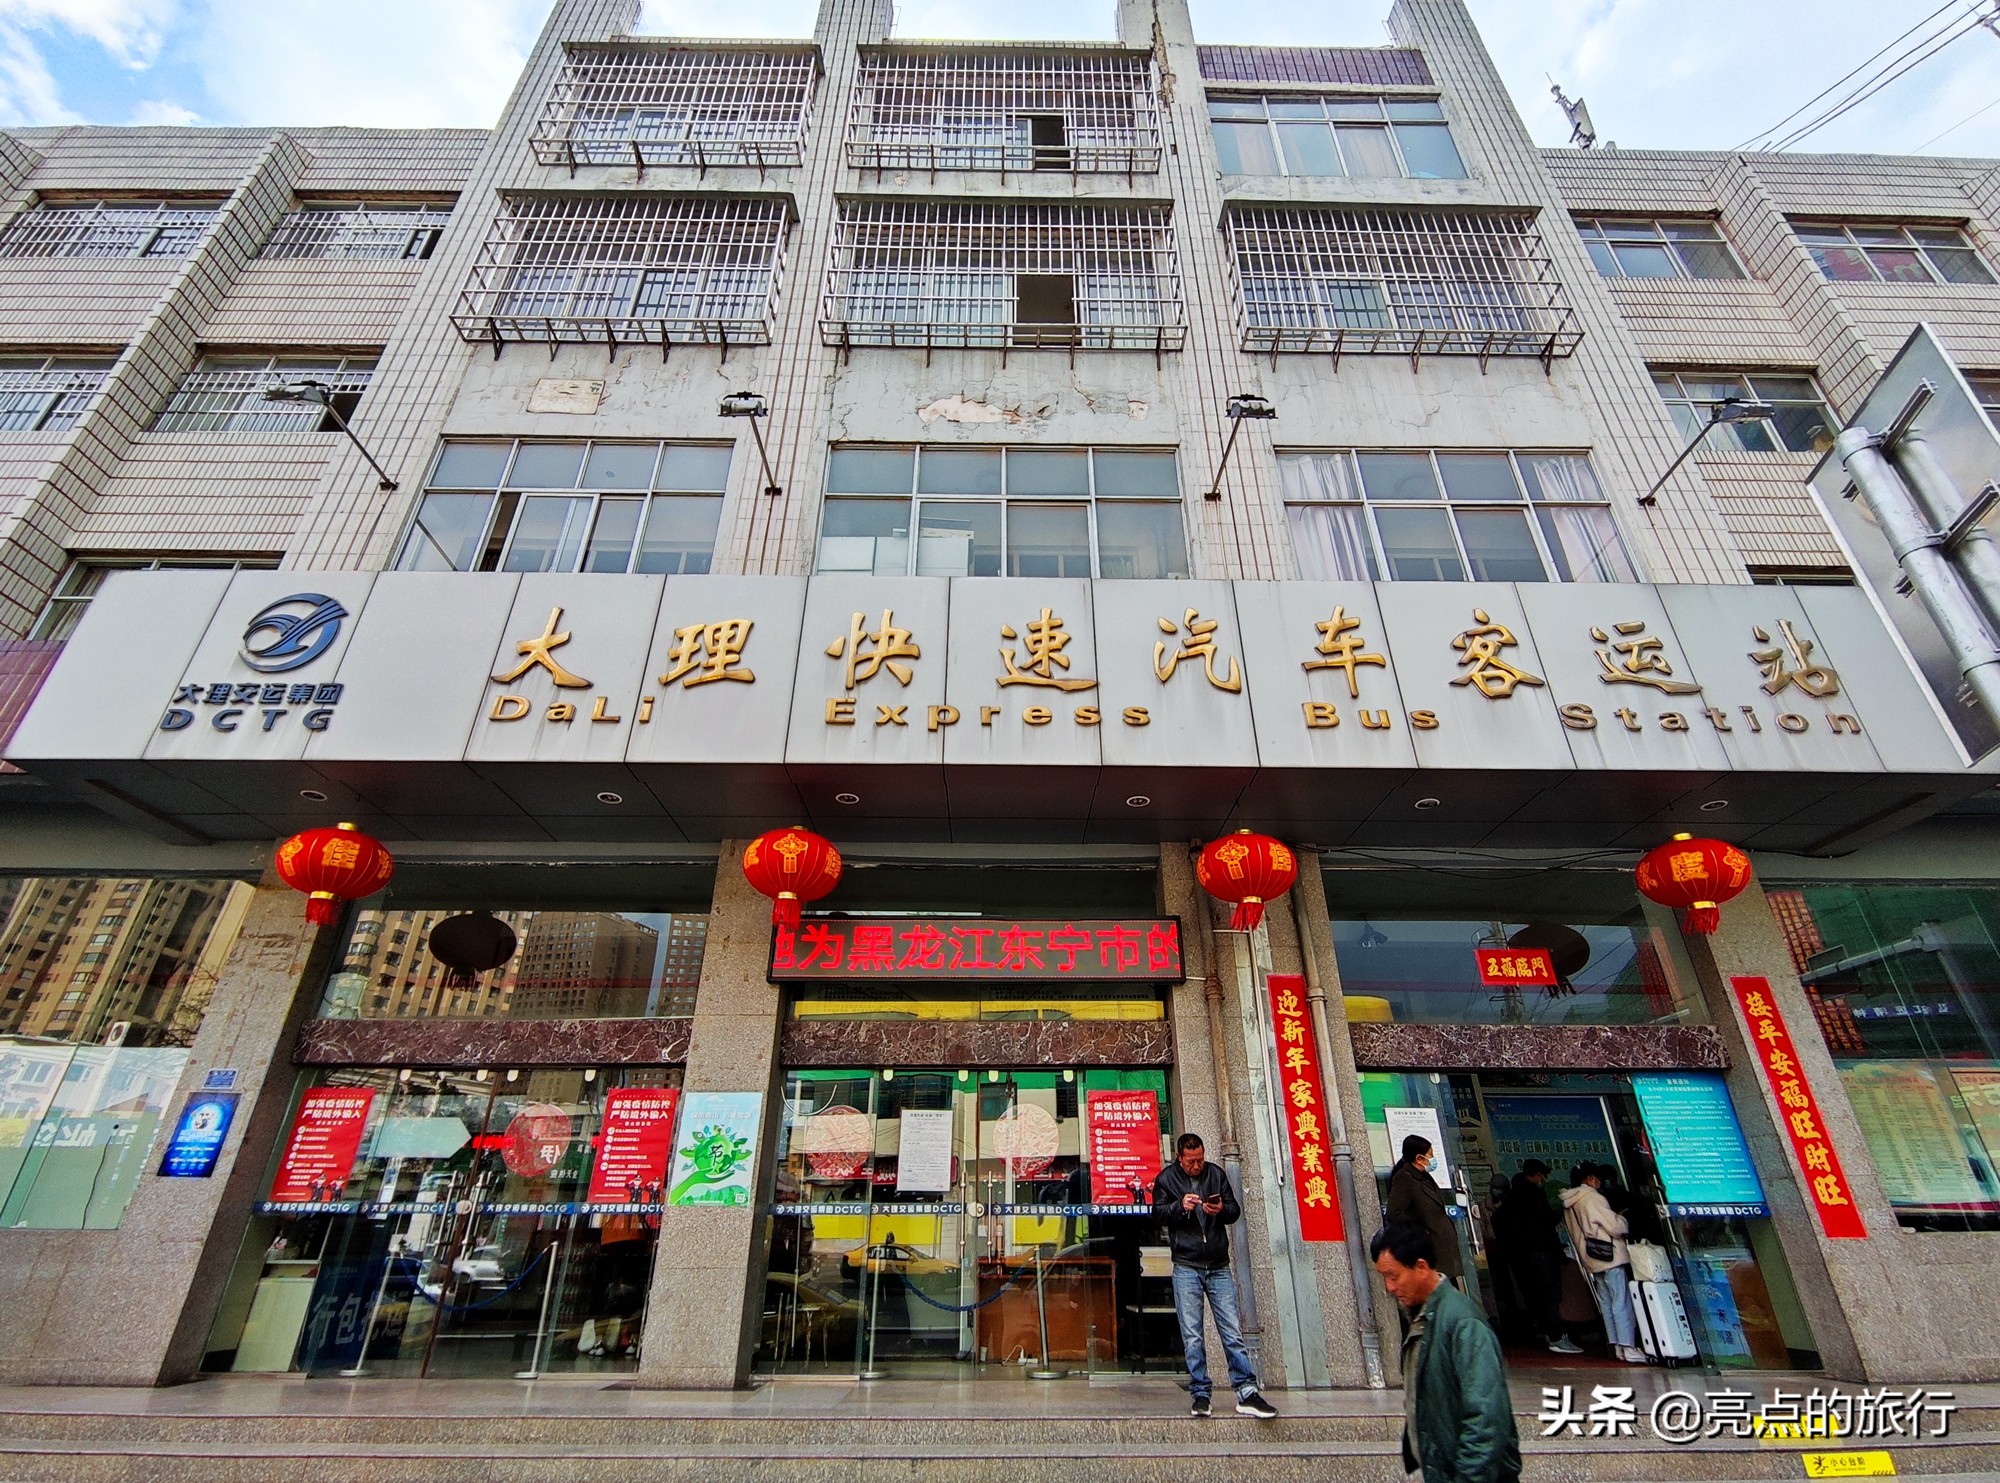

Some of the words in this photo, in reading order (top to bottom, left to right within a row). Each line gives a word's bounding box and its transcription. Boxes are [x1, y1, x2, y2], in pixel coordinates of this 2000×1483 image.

[490, 605, 1841, 699] 大理快速汽车客运站
[175, 683, 345, 705] 大理交运集团
[159, 708, 334, 731] DCTG
[825, 698, 1151, 732] Express
[1301, 702, 1440, 730] Bus
[1560, 703, 1862, 734] Station
[1487, 956, 1549, 978] 五福臨門
[609, 1110, 668, 1120] 严防境外输入
[612, 1100, 671, 1109] 加强疫情防控
[1094, 1101, 1151, 1111] 加强疫情防控
[1094, 1111, 1152, 1121] 严防境外输入
